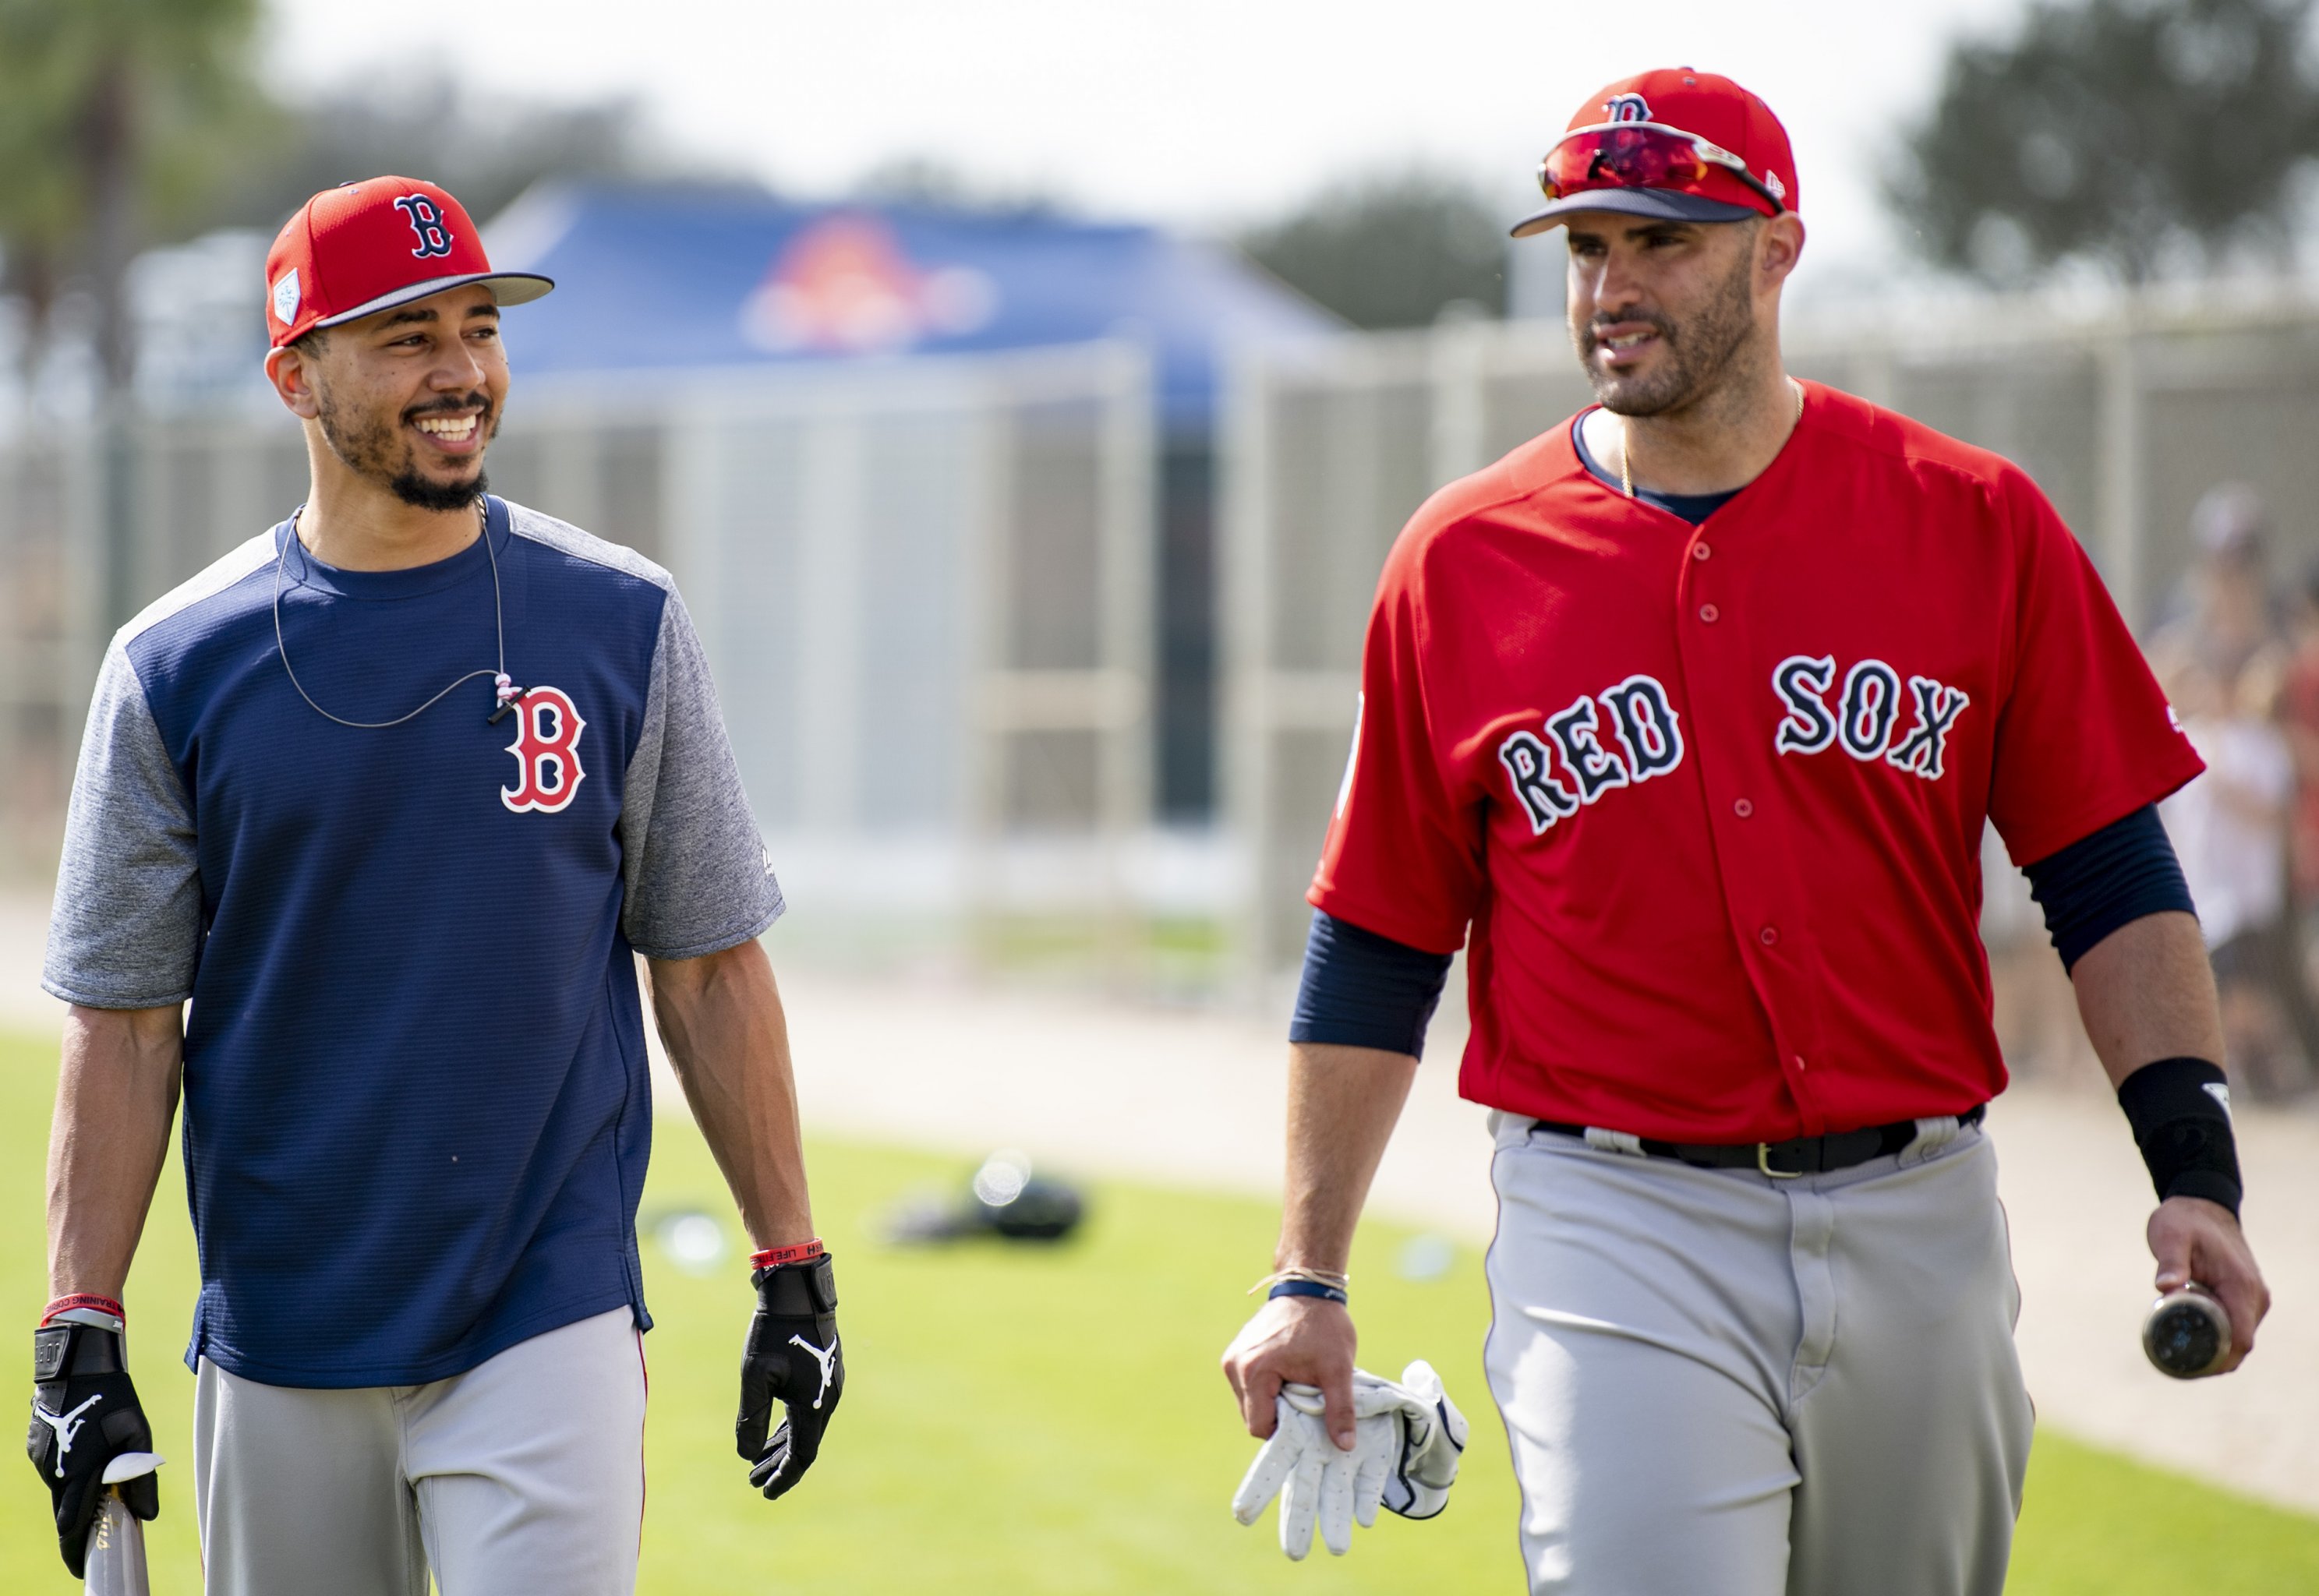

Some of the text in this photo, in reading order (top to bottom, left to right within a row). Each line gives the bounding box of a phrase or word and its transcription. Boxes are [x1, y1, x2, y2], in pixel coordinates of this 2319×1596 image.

[394, 193, 454, 259] B
[497, 686, 587, 814] B
[1498, 653, 1970, 836] RED SOX
[42, 1294, 115, 1317] TRAINING CORNE
[35, 1342, 60, 1364] JOR
